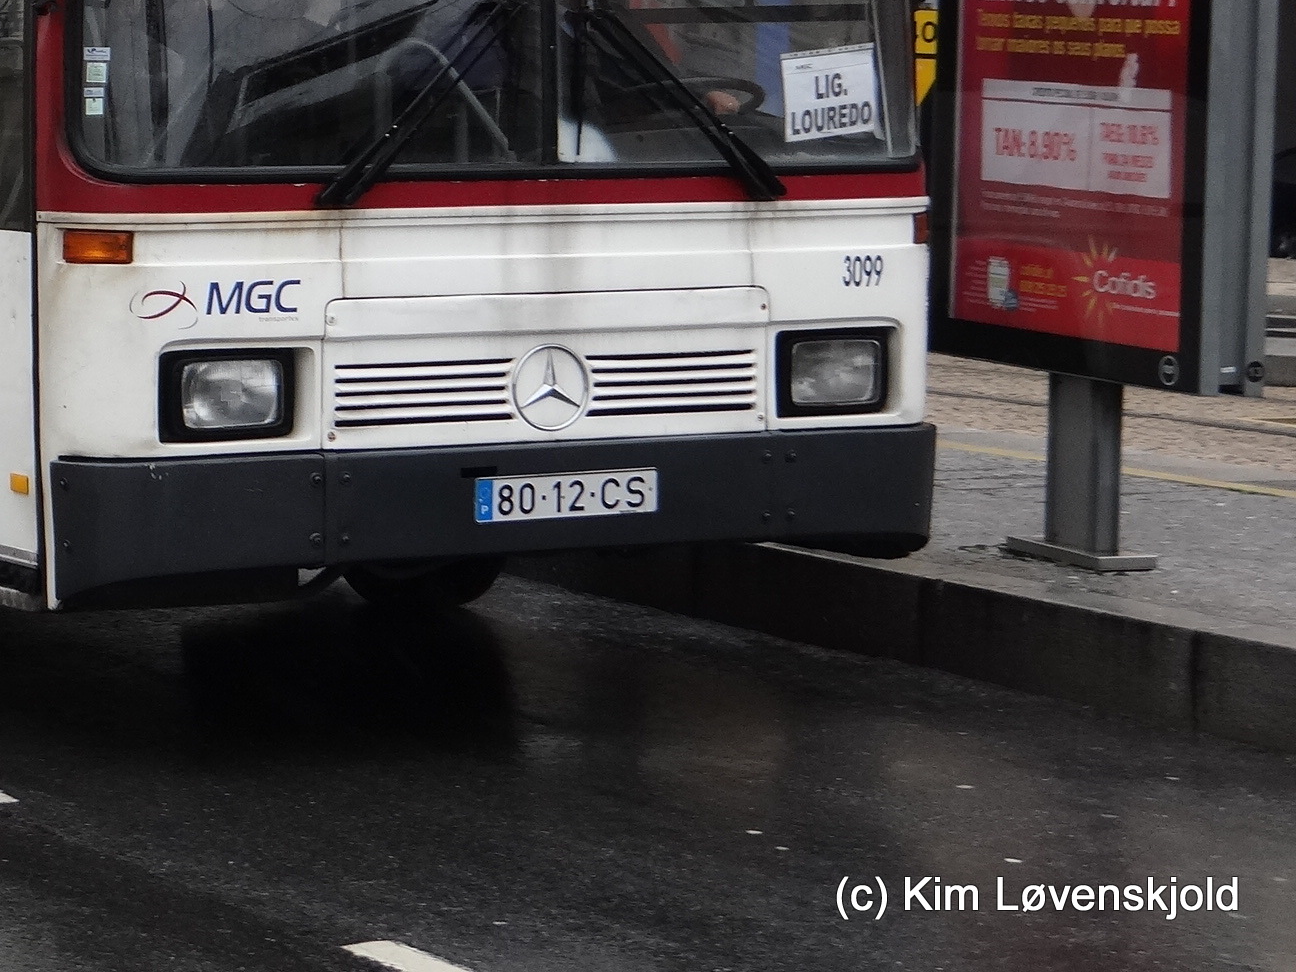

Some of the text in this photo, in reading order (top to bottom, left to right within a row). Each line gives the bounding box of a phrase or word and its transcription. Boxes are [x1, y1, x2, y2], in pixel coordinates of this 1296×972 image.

[815, 73, 848, 100] LIG.
[791, 101, 872, 135] LOUREDO
[842, 254, 884, 287] 3099
[1093, 269, 1157, 300] Cofidis
[206, 280, 301, 315] MGC
